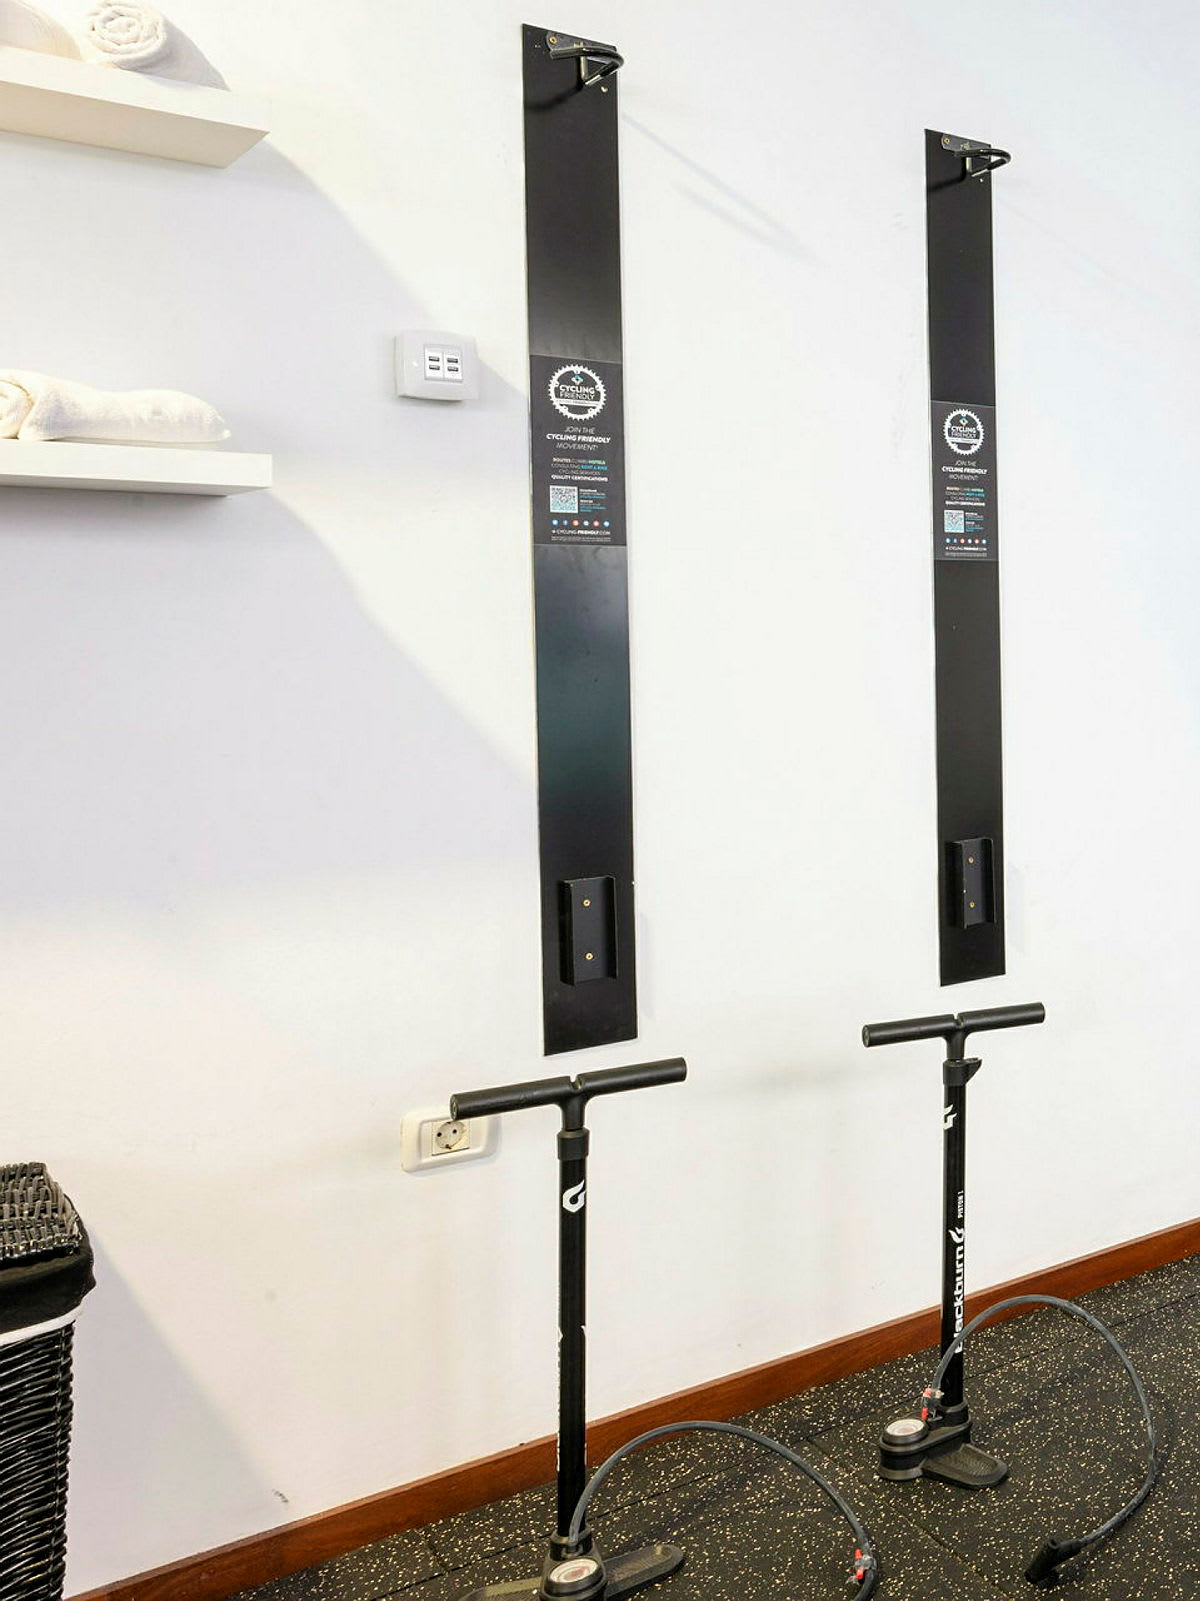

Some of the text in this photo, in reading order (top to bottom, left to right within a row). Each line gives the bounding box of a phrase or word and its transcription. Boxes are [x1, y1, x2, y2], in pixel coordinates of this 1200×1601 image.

[560, 384, 595, 394] CYCLING
[560, 391, 595, 400] FRIENDLY
[546, 433, 611, 443] CYCLING FRIENDLY
